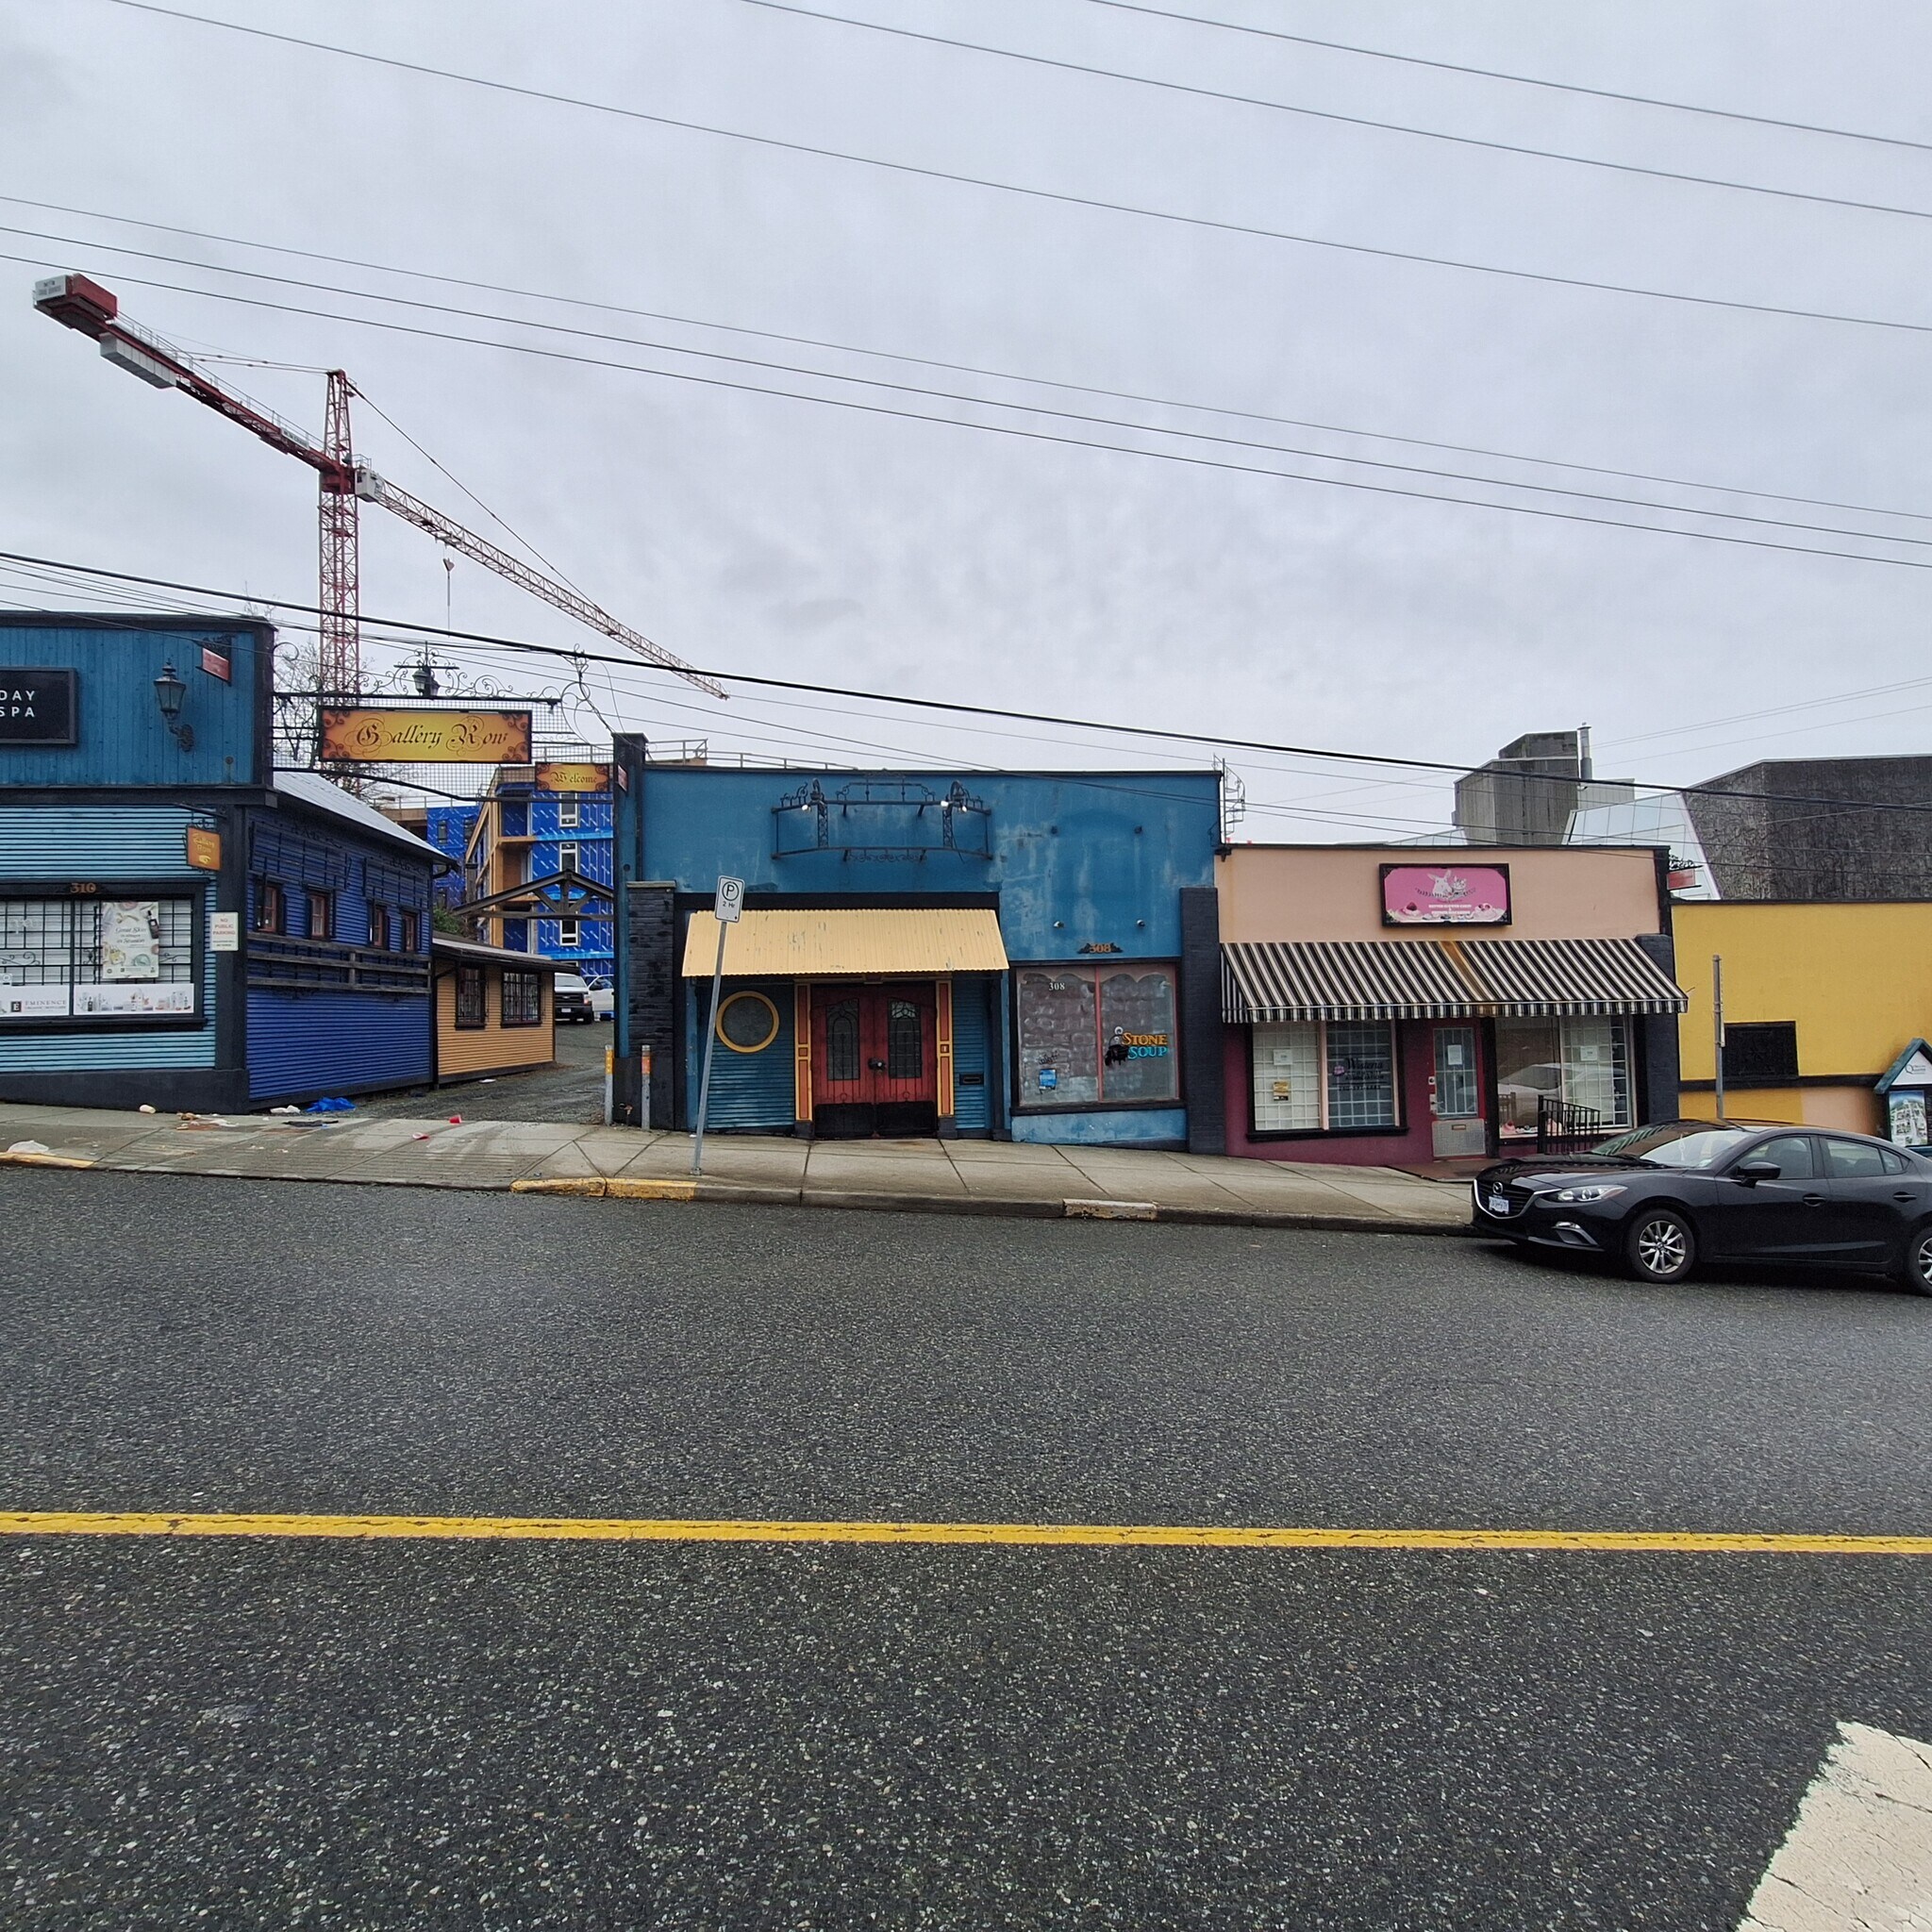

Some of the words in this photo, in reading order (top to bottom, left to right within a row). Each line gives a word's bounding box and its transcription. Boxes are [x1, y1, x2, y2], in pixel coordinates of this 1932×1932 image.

[0, 690, 35, 701] DAY
[0, 707, 35, 717] SPA
[349, 719, 442, 753] Gallery
[447, 718, 508, 752] Row
[550, 772, 597, 783] Welcome
[71, 882, 96, 893] 310
[1089, 943, 1112, 954] 308
[1048, 982, 1066, 991] 308
[1121, 1032, 1168, 1045] STONE
[1127, 1046, 1168, 1059] SOUP
